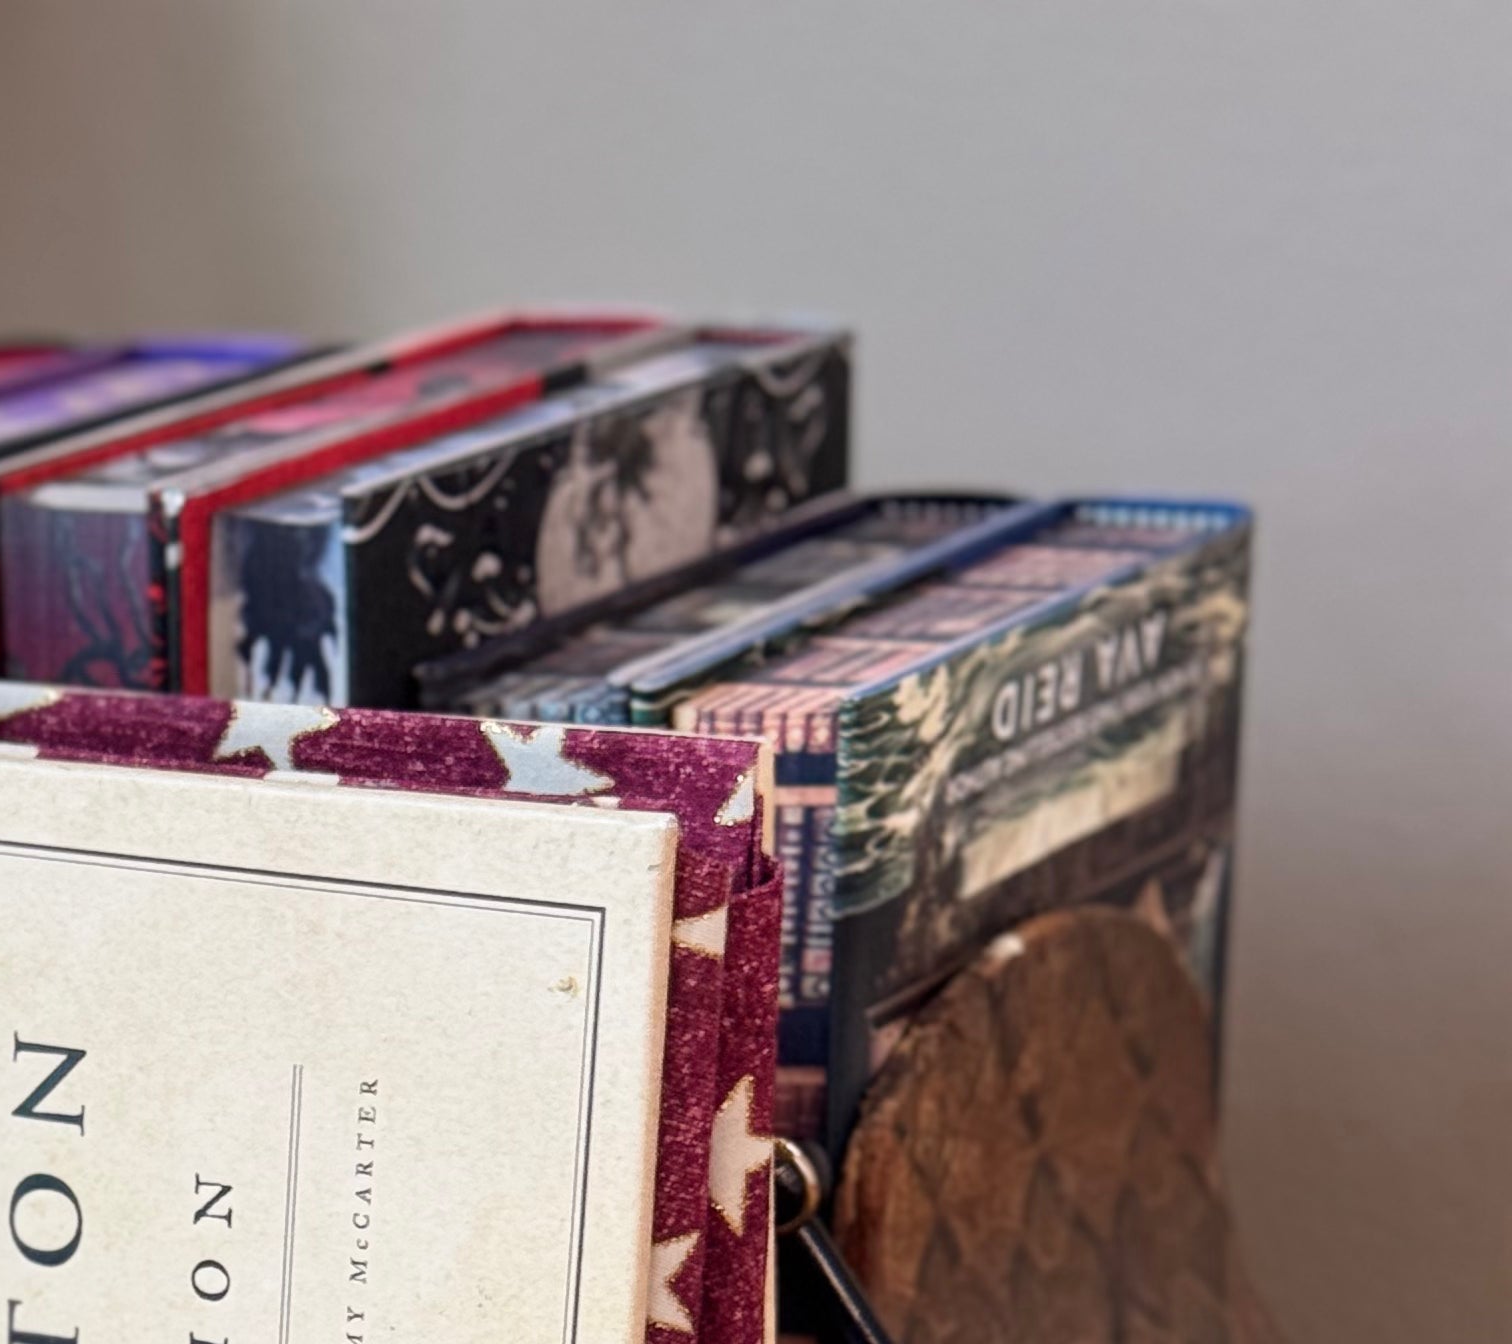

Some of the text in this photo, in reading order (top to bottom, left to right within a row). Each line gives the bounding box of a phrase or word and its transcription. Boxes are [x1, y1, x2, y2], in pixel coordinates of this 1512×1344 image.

[991, 651, 1084, 742] REID
[1093, 611, 1168, 691] AVA
[348, 1078, 379, 1285] McCARTER
